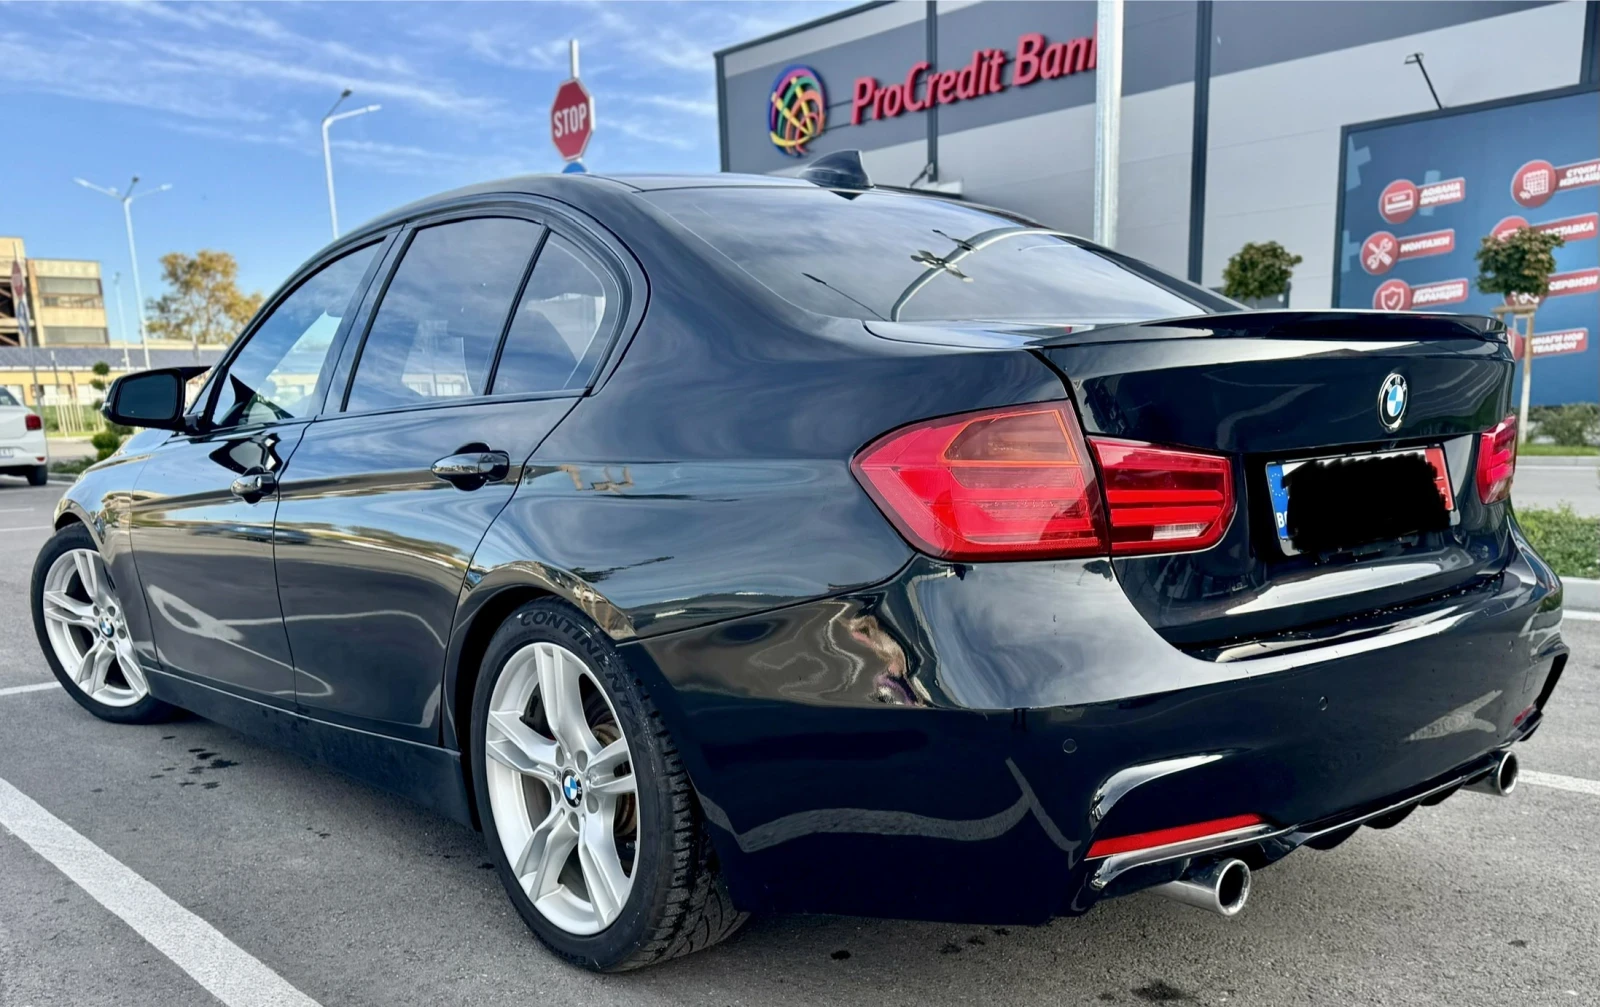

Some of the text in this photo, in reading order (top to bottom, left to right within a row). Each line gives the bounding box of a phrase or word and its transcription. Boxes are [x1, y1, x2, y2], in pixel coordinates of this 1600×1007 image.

[850, 49, 1006, 126] ProCredit
[553, 103, 588, 138] STOP
[1276, 511, 1288, 528] B
